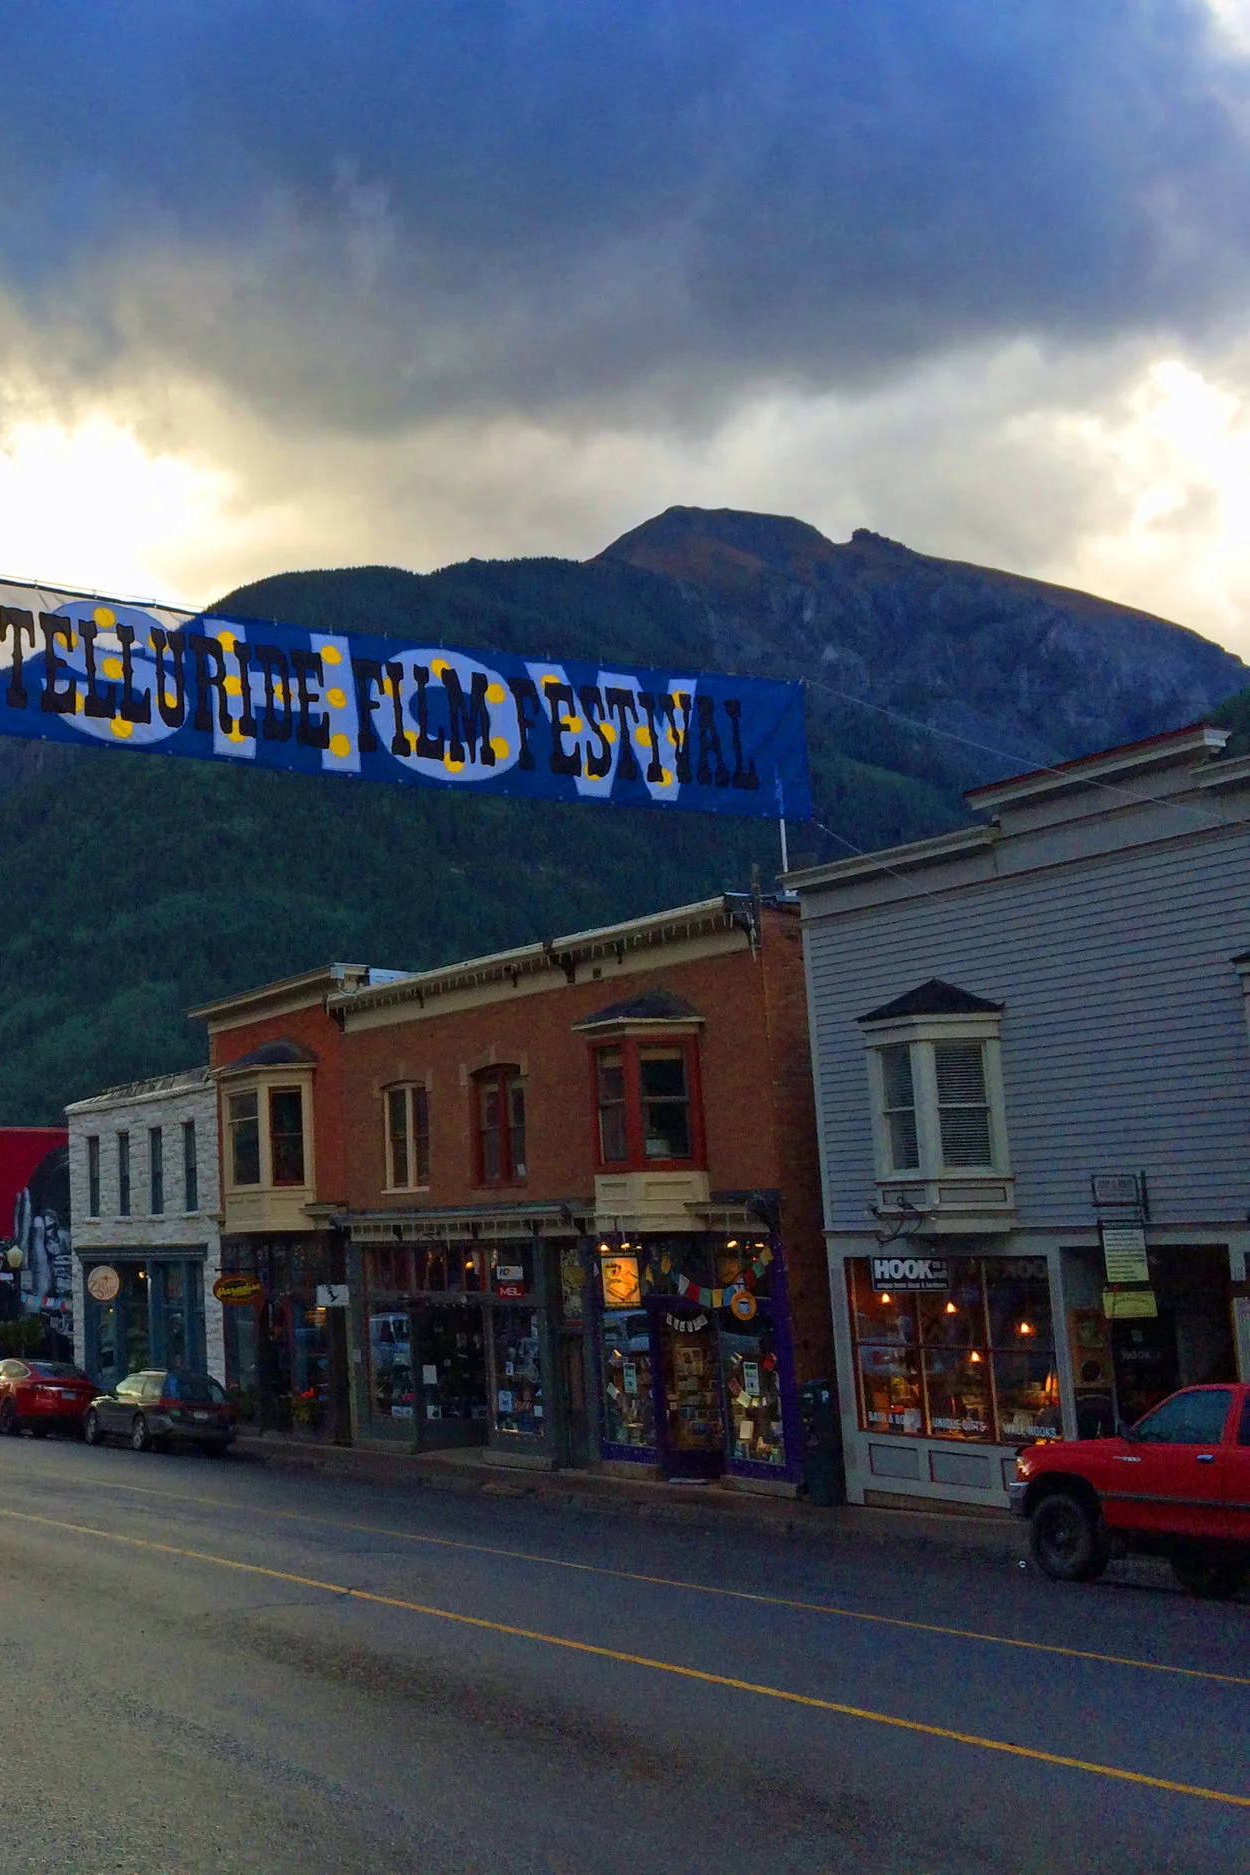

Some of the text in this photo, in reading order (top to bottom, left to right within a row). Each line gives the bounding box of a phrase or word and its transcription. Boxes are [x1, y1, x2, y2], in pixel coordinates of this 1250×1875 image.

[352, 658, 496, 766] FILM
[507, 677, 760, 790] FESTIVAL
[874, 1259, 934, 1279] HOOK
